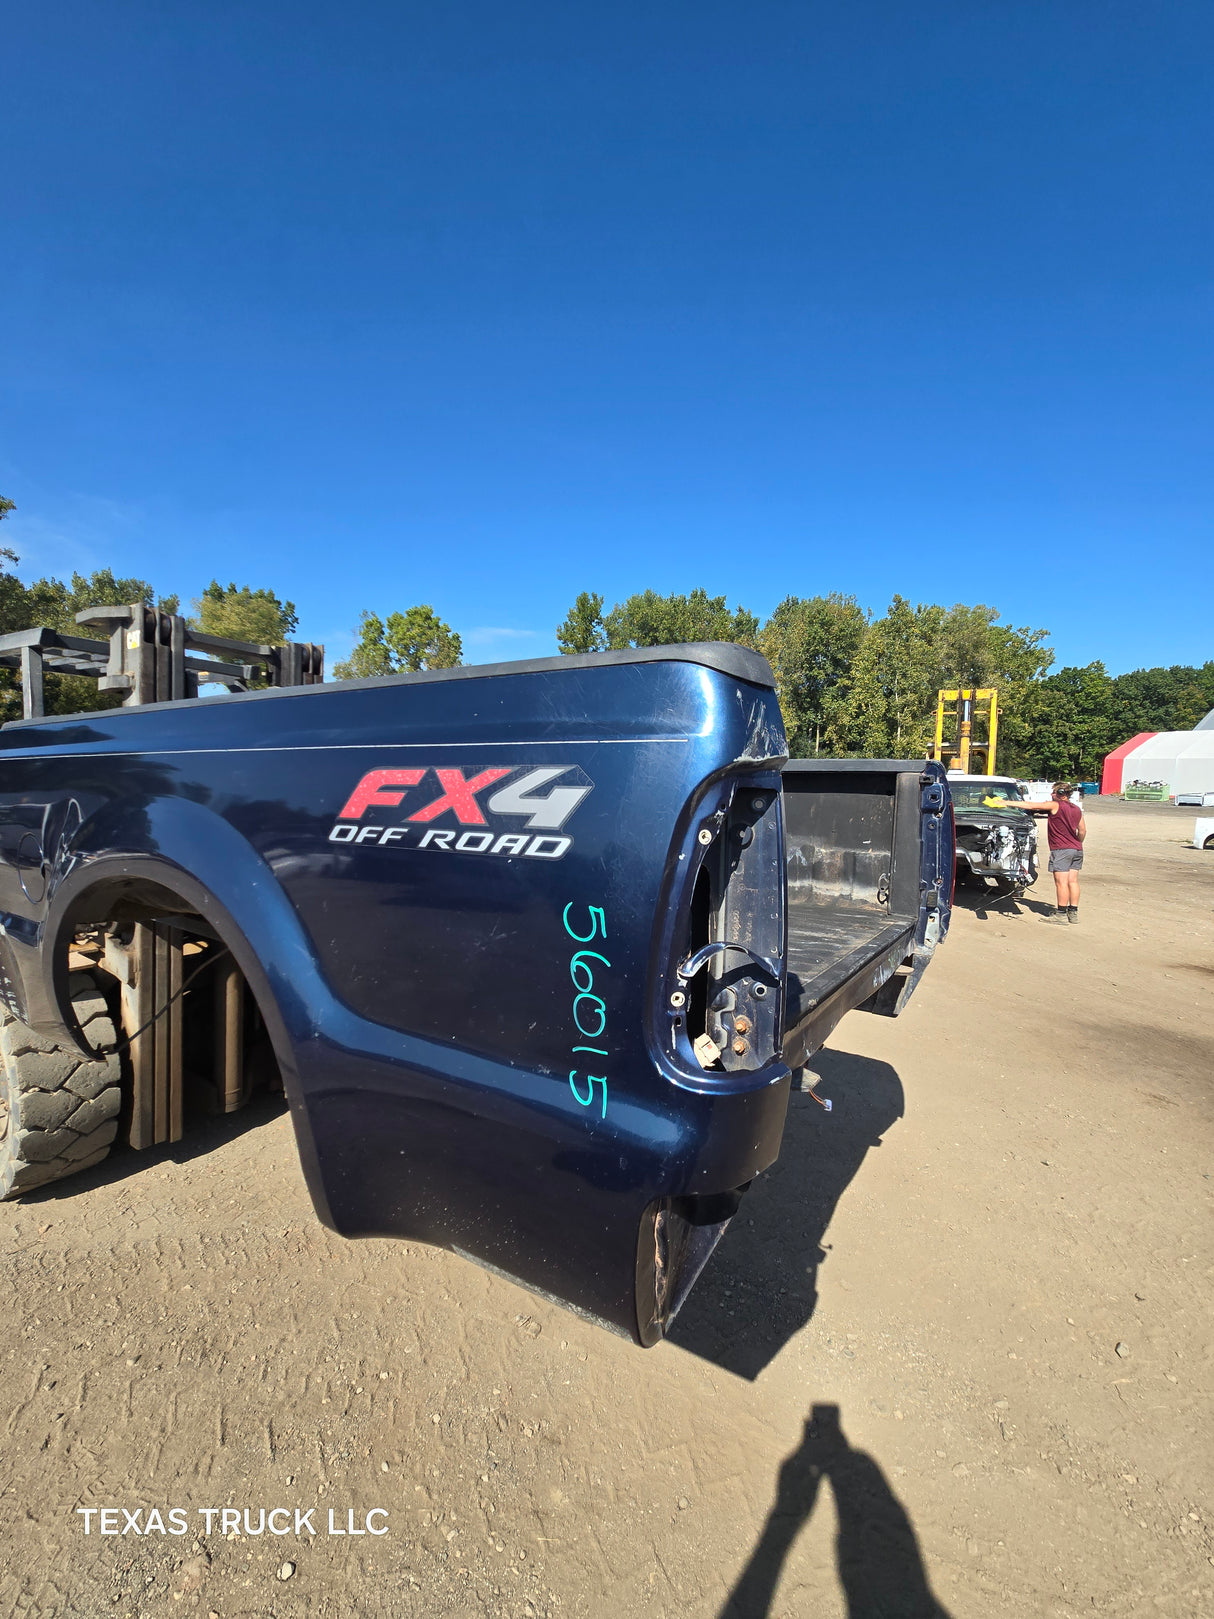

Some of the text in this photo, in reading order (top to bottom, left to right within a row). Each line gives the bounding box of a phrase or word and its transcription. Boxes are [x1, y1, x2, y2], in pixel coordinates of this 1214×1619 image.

[337, 766, 594, 829] FX4
[328, 824, 574, 858] OFF ROAD
[562, 901, 612, 1119] 56015
